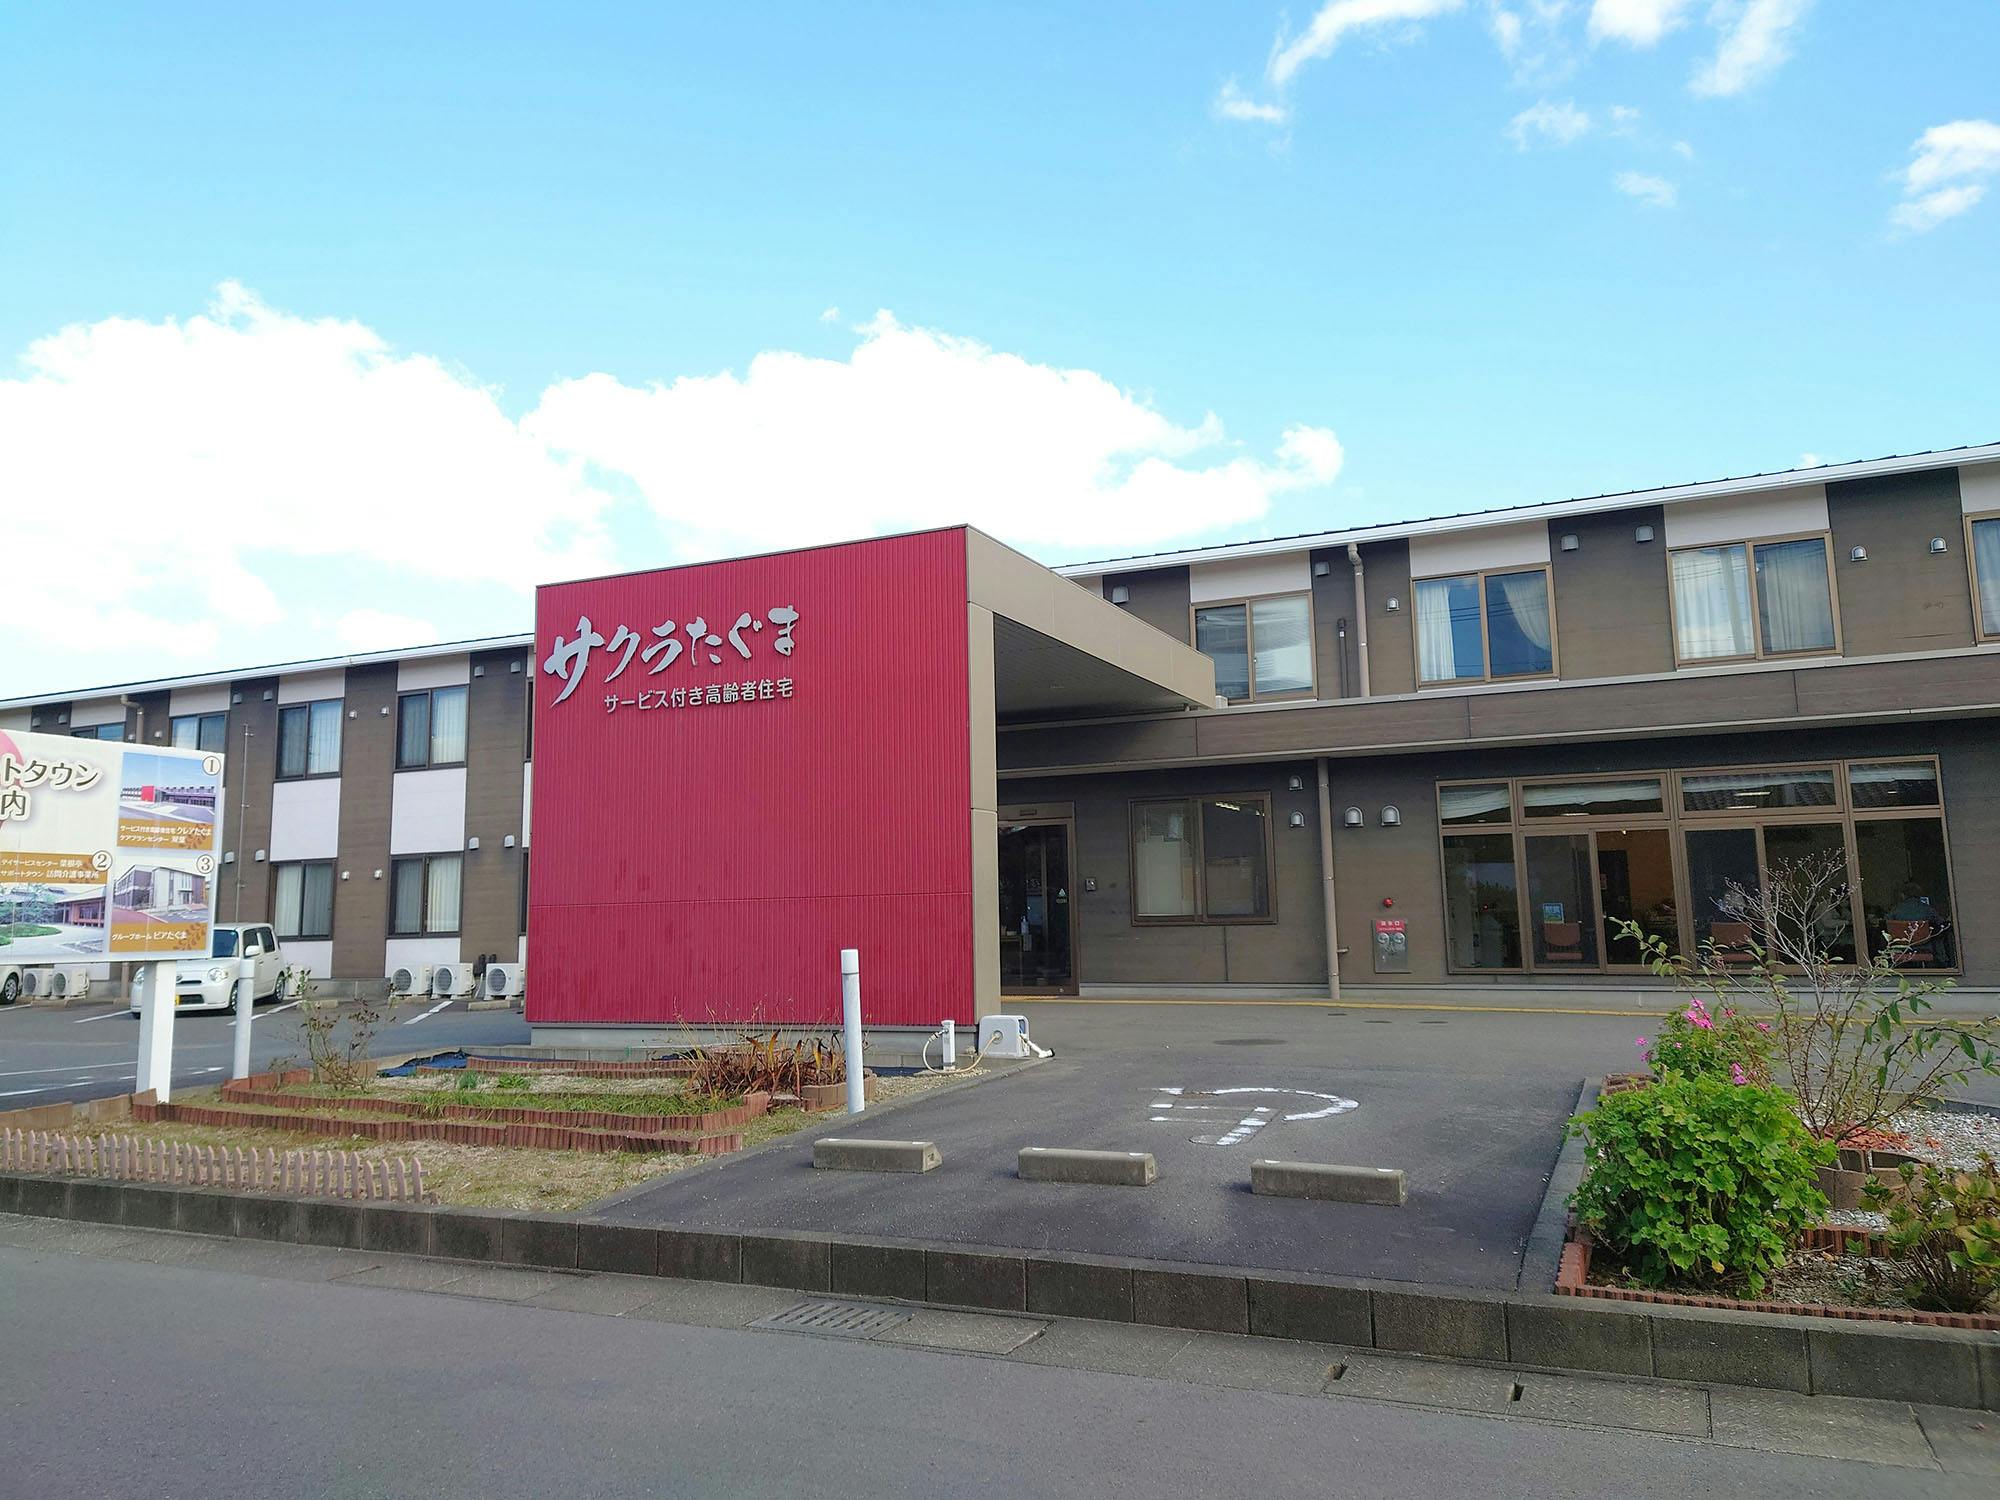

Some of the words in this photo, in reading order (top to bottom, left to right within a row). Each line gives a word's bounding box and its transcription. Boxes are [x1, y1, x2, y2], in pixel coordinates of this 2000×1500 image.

[604, 677, 793, 713] サービス付き高齢者住宅
